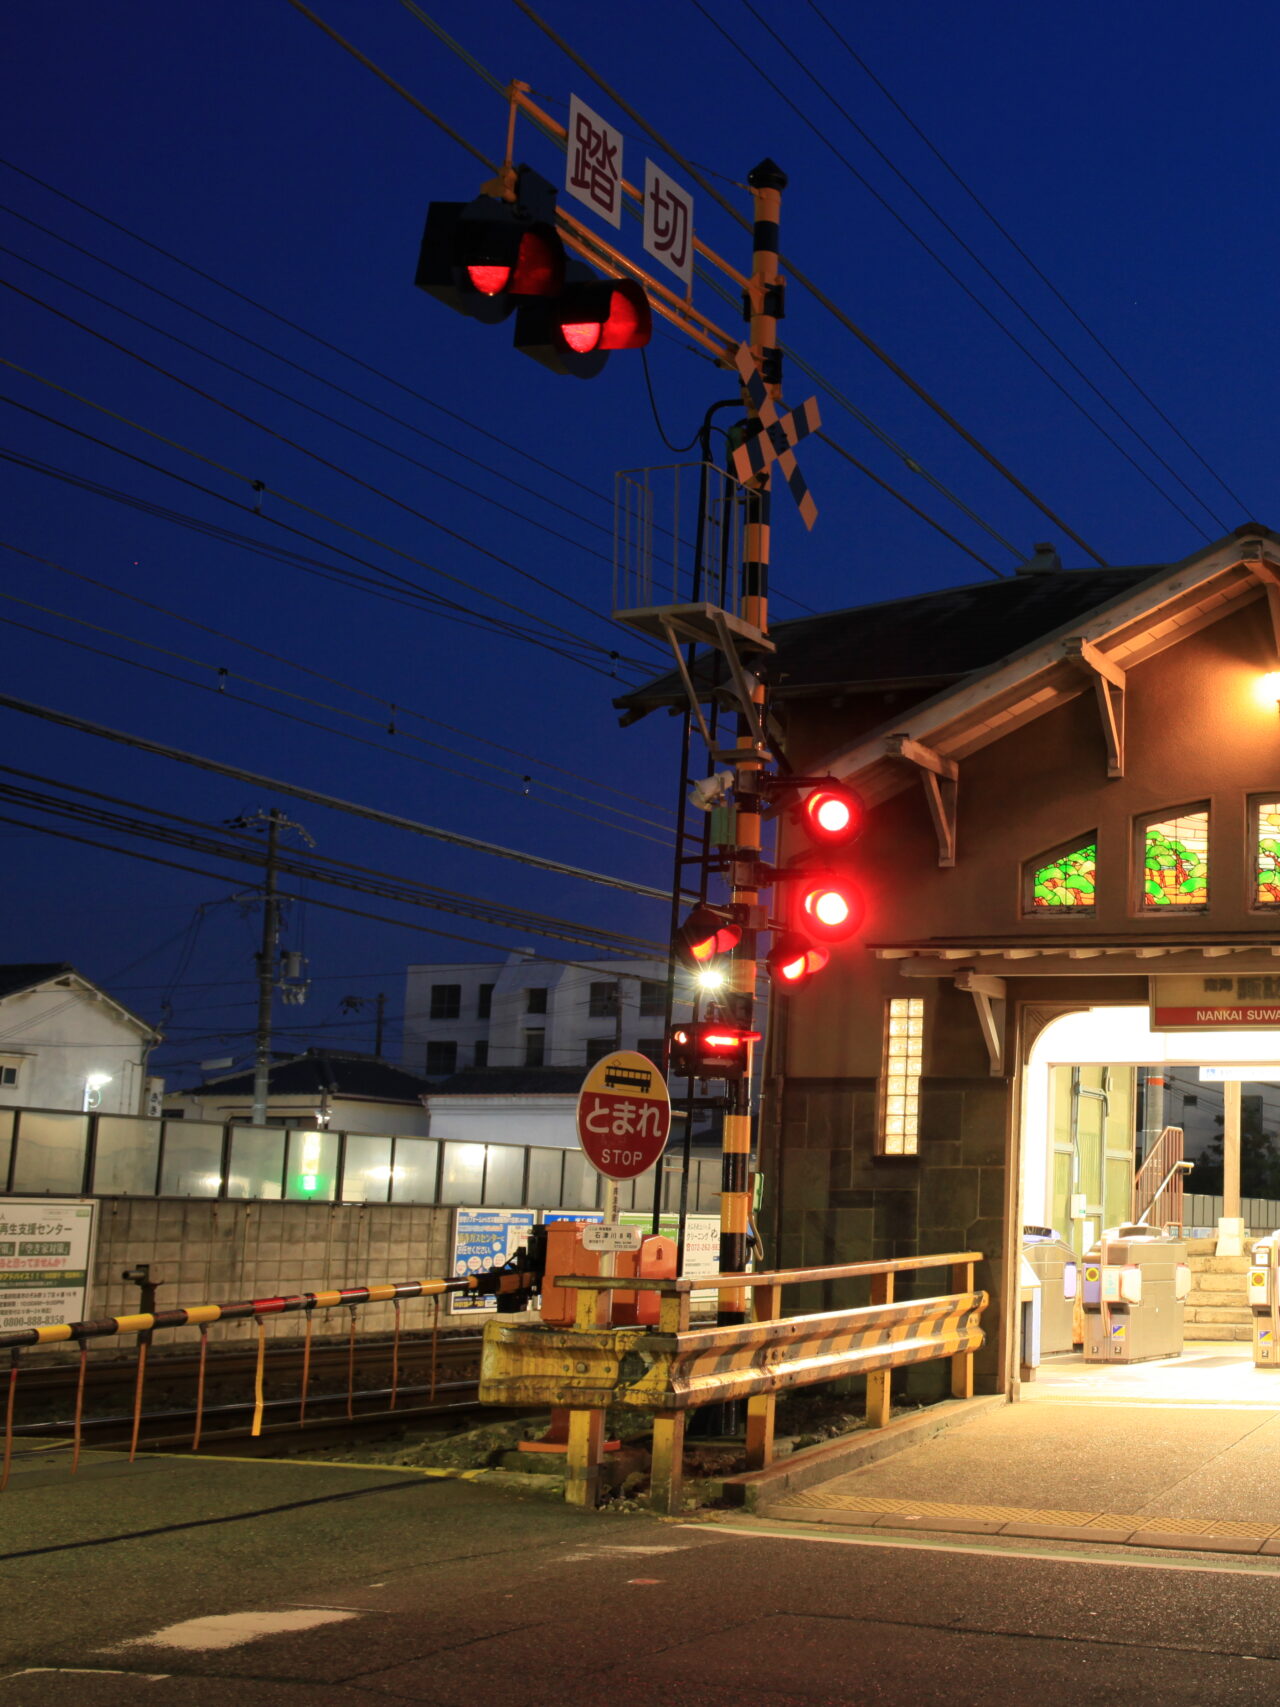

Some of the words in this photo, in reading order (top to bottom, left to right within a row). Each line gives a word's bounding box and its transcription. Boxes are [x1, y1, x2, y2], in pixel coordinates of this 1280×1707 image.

[570, 111, 688, 268] 踏切
[1196, 1010, 1242, 1021] NANKAI
[585, 1097, 662, 1138] とまれ
[601, 1148, 643, 1166] STOP
